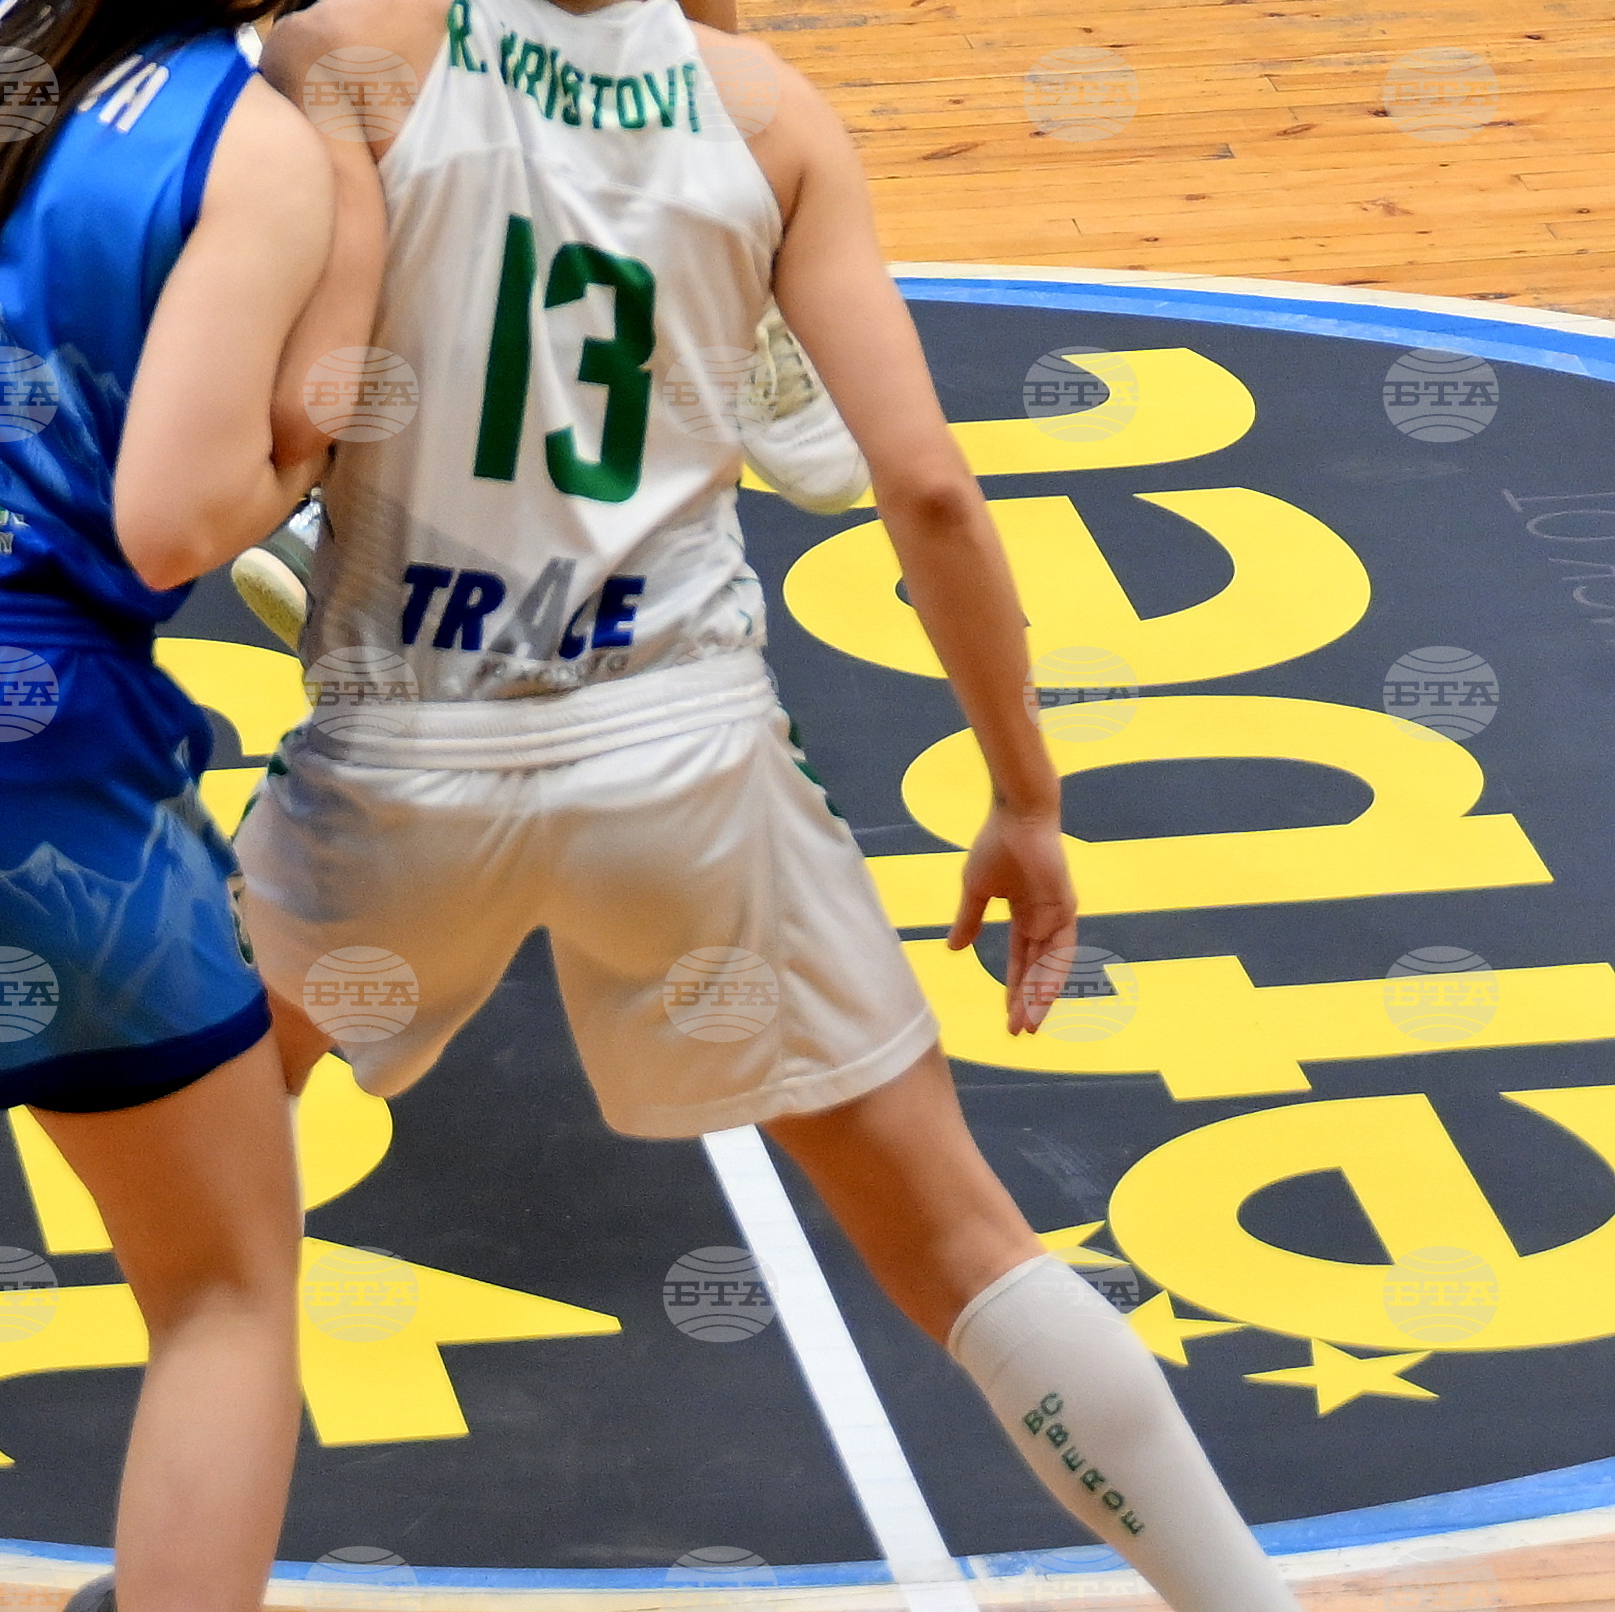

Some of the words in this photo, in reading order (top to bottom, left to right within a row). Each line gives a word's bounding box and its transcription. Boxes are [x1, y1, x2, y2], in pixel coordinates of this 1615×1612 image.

[473, 214, 658, 503] 13
[1024, 1392, 1064, 1435] BC
[1045, 1422, 1145, 1535] BEROE
